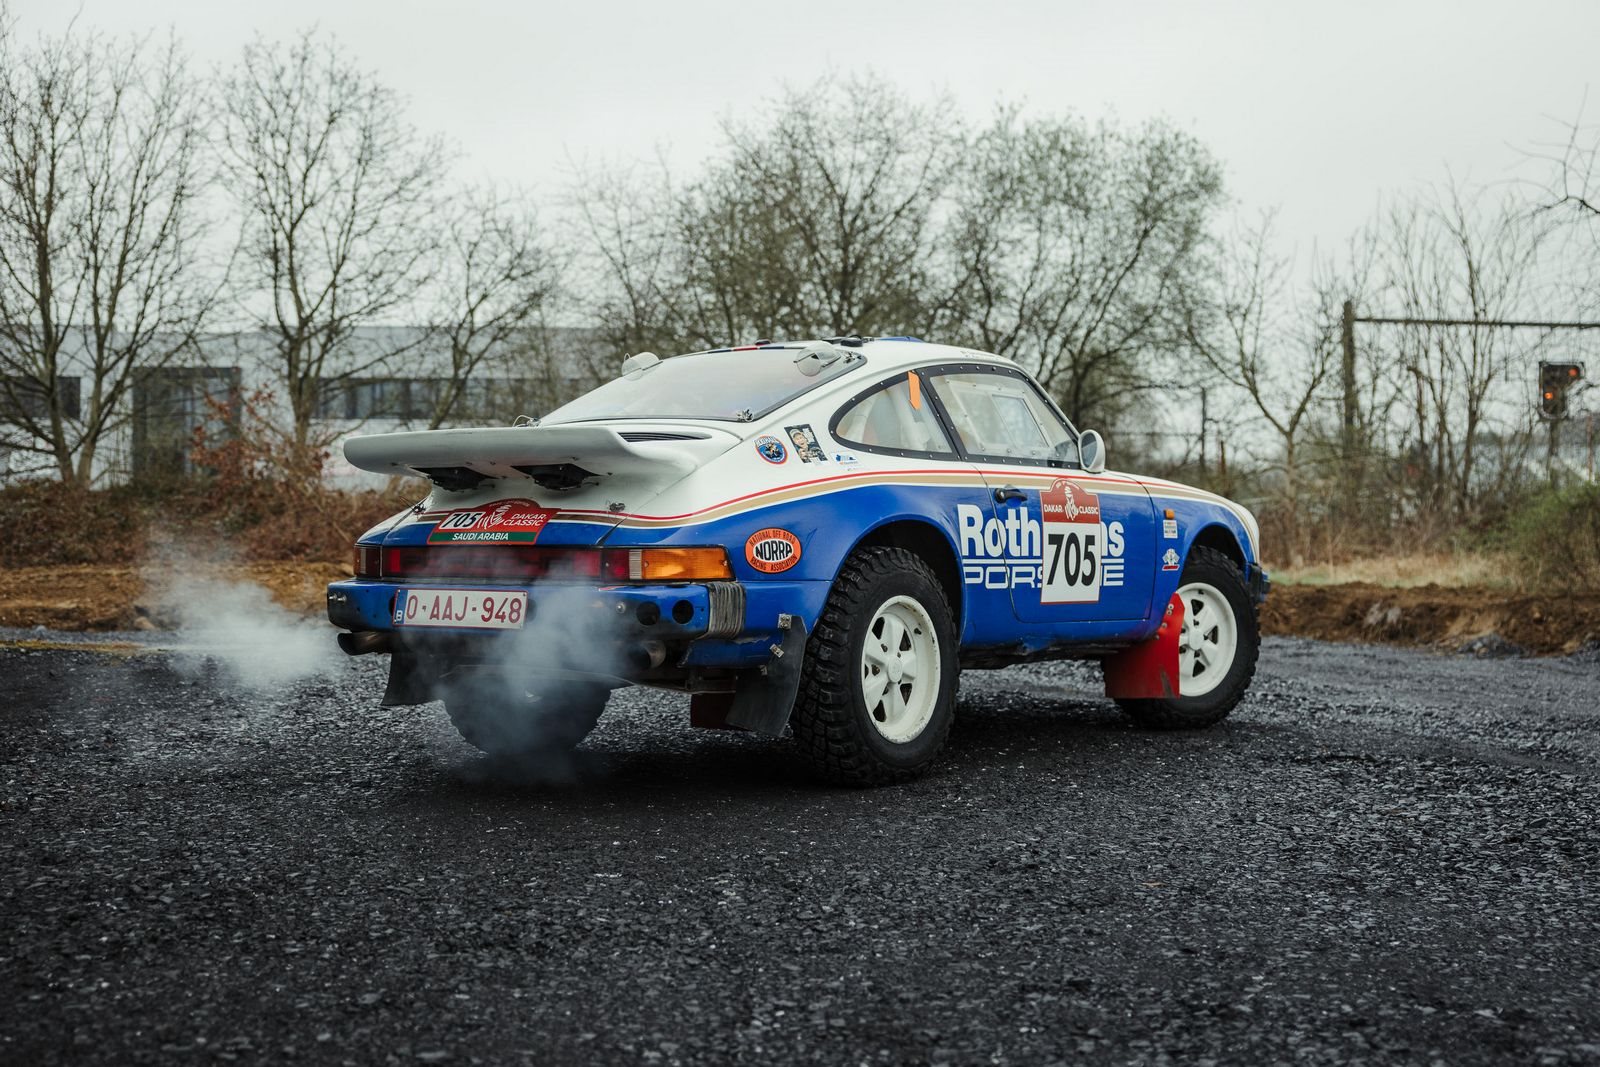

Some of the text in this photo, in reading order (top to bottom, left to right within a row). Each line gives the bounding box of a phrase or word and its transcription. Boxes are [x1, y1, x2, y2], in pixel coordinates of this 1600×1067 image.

[1044, 504, 1099, 515] DAKAR CLASSIC
[442, 512, 482, 528] 705
[503, 519, 544, 527] CLASSIC
[452, 532, 509, 541] SAUDI ARABIA
[749, 530, 772, 546] NATIONAL
[957, 504, 1125, 557] Roths
[755, 540, 792, 561] NORRA
[1046, 532, 1096, 587] 705
[963, 565, 1124, 590] PORE
[396, 610, 403, 621] B
